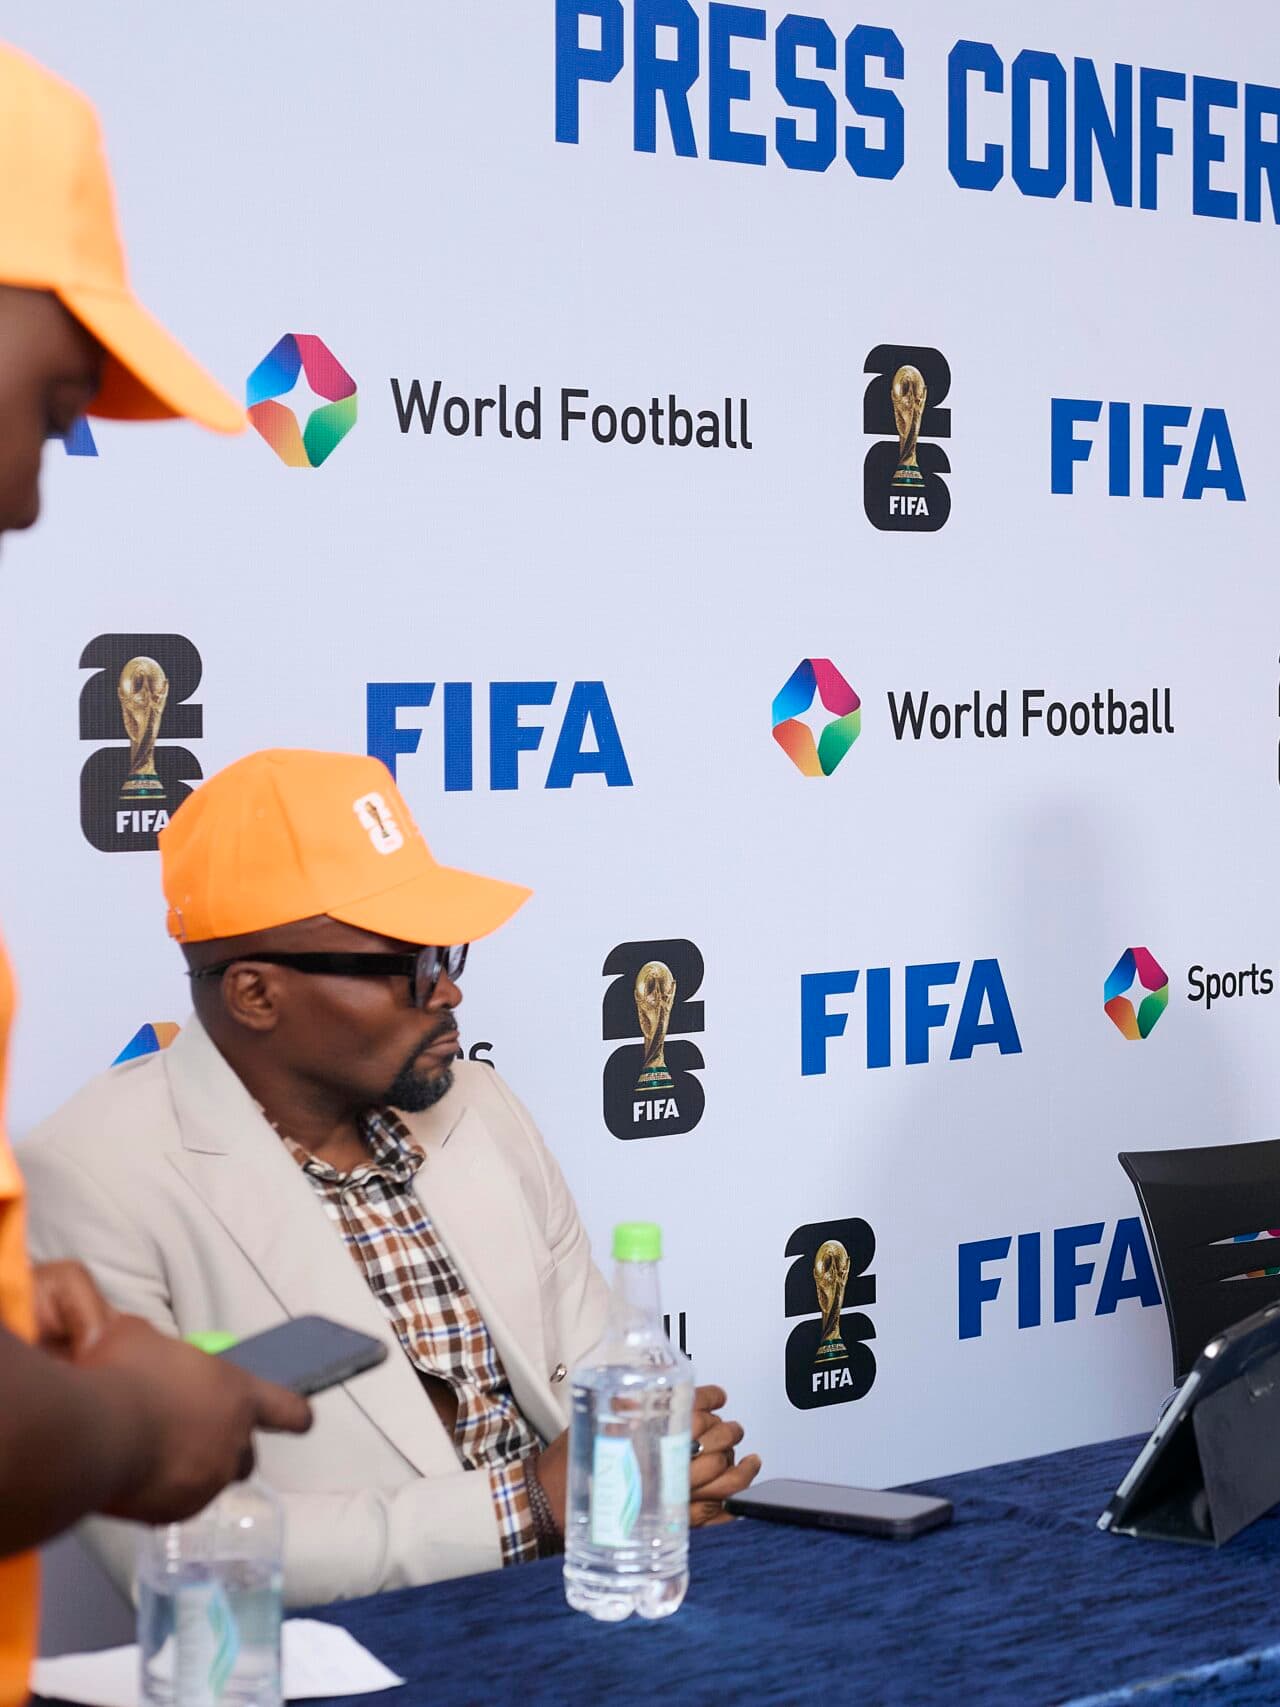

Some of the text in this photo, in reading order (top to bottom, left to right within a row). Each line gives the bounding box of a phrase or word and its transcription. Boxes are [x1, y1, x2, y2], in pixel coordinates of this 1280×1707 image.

[555, 0, 904, 180] PRESS
[390, 377, 753, 450] World Football
[1051, 397, 1247, 502] FIFA
[889, 495, 930, 517] FIFA
[366, 681, 634, 792] FIFA
[887, 687, 1175, 741] World Football
[116, 809, 170, 833] FIFA
[800, 958, 1023, 1077] FIFA
[1187, 963, 1274, 1010] Sports
[633, 1098, 680, 1123] FIFA
[958, 1216, 1163, 1341] FIFA
[812, 1366, 854, 1393] FIFA
